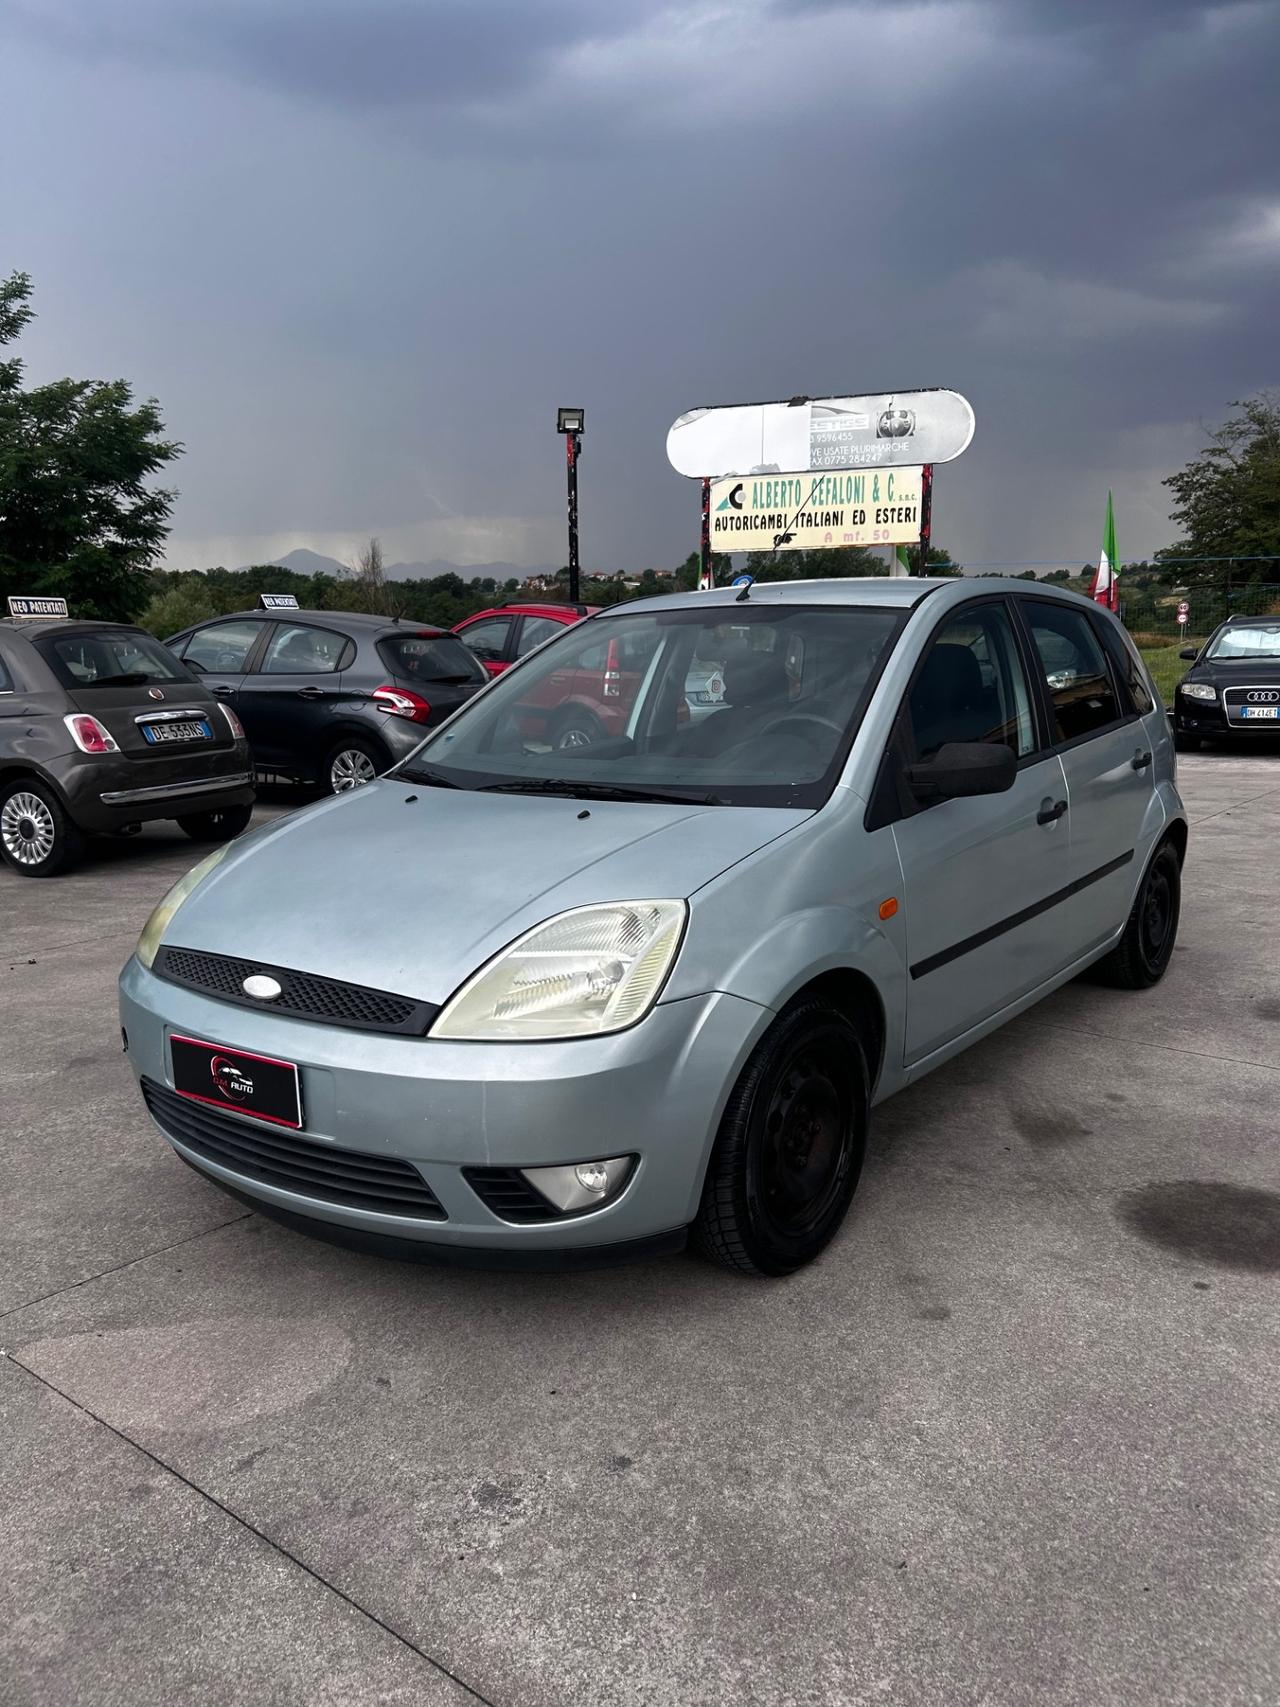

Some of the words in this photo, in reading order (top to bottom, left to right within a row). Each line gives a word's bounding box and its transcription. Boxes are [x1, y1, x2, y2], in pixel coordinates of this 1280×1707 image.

[824, 444, 849, 456] USATE
[851, 441, 910, 454] PLURIMARCHE
[825, 455, 847, 465] 0775
[752, 478, 801, 510] ALBERTO
[811, 475, 865, 506] CEFALONI
[872, 473, 880, 503] &
[714, 513, 788, 531] AUTORICAMBI
[795, 510, 844, 529] ITALIANI
[852, 509, 866, 525] ED
[875, 506, 917, 525] ESTERI
[824, 531, 833, 543] A
[873, 529, 890, 541] 50
[11, 600, 28, 613] NEO
[28, 600, 66, 613] PATENTATI
[151, 726, 168, 740] DE
[169, 722, 205, 738] 533NS
[231, 1081, 254, 1094] AUTO
